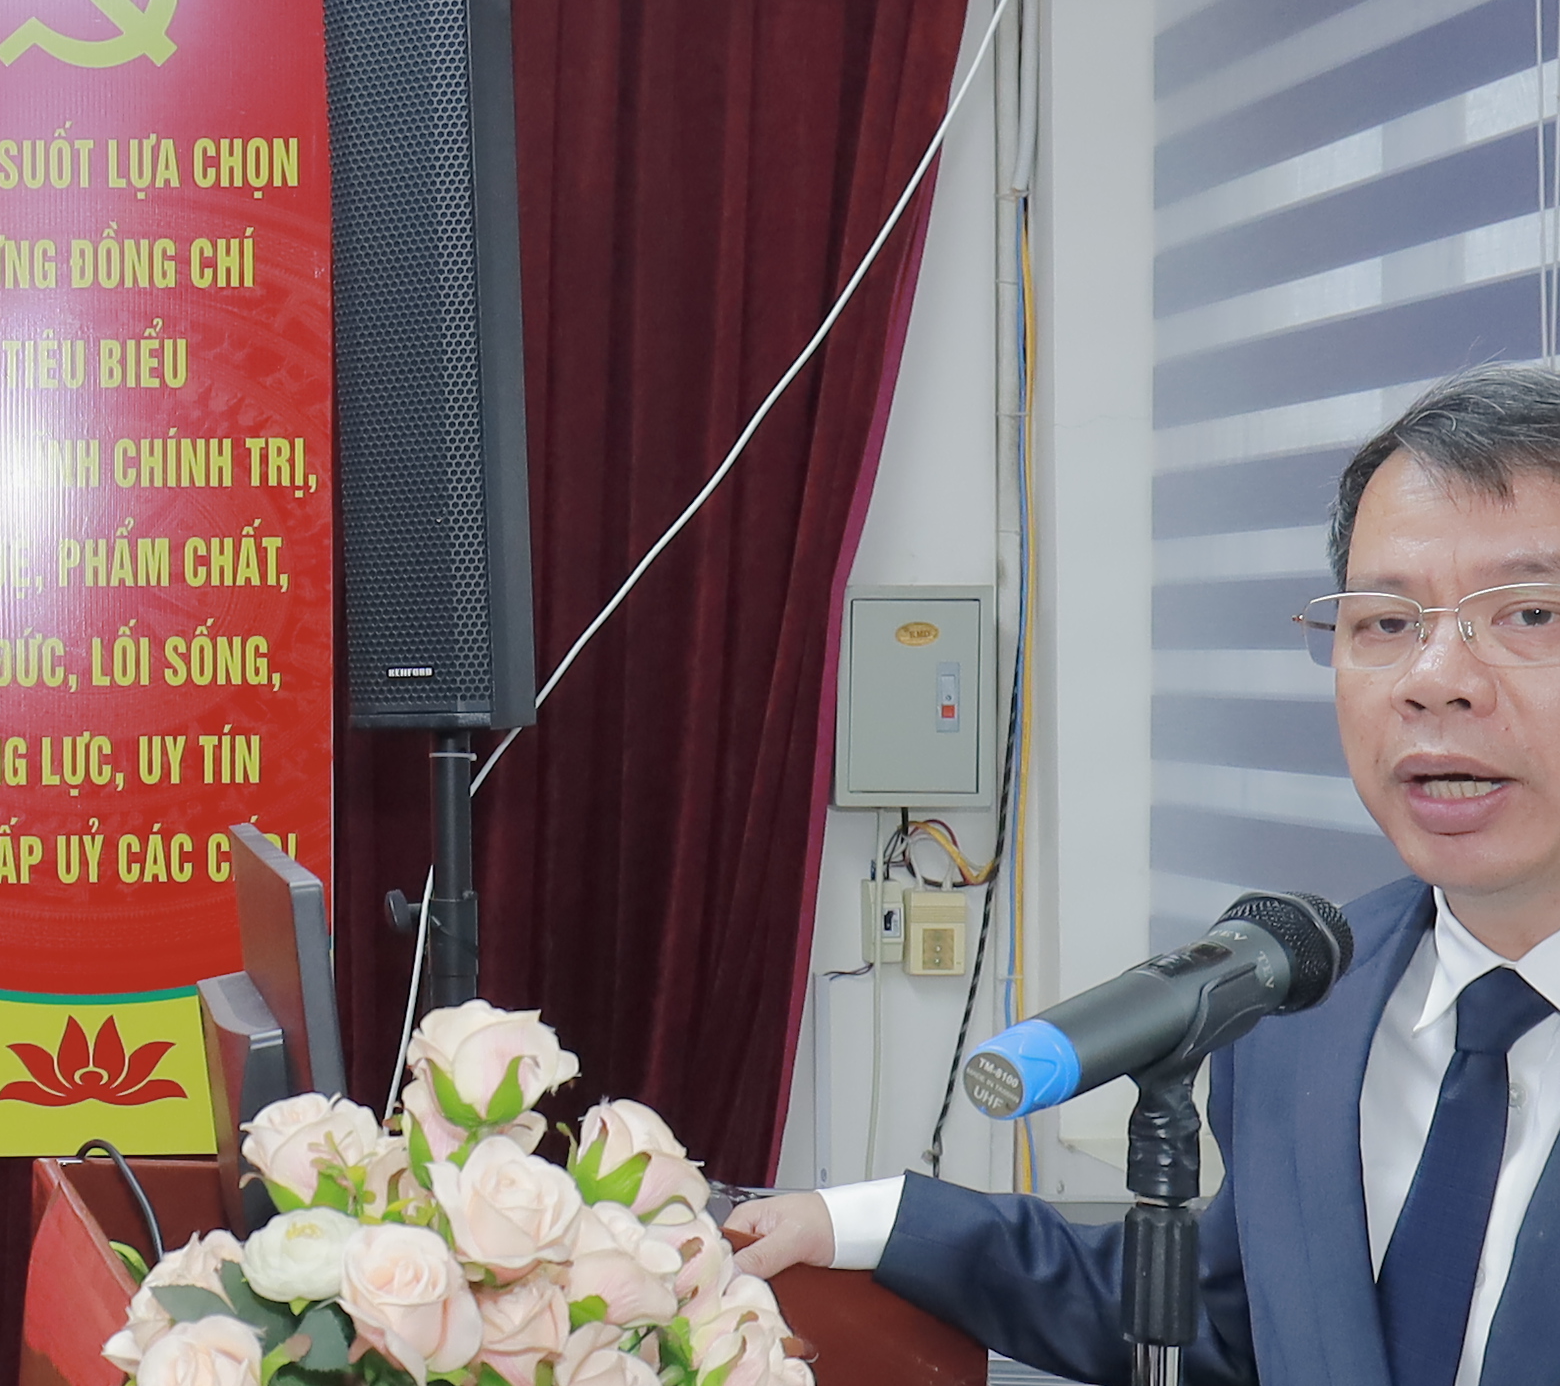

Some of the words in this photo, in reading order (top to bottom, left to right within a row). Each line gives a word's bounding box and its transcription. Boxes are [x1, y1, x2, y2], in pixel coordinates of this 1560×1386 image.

[109, 134, 181, 198] LỰA
[194, 138, 300, 197] CHỌN
[72, 222, 178, 288] ĐỒNG
[191, 227, 255, 288] CHÍ
[3, 329, 86, 389] TIÊU
[101, 319, 188, 389] BIỂU
[13, 430, 99, 488] ĨNH
[117, 428, 234, 487] CHÍNH
[245, 438, 318, 497] TRỊ,
[62, 517, 170, 587] PHẨM
[185, 519, 289, 592] CHẤT,
[93, 619, 149, 687] LỐI
[166, 619, 281, 691] SỐNG,
[41, 733, 125, 795] LỰC,
[140, 737, 186, 784] UY
[200, 725, 259, 783] TÍN
[57, 818, 104, 884] UỶ
[120, 824, 192, 883] CÁC
[973, 1085, 1004, 1109] UHF
